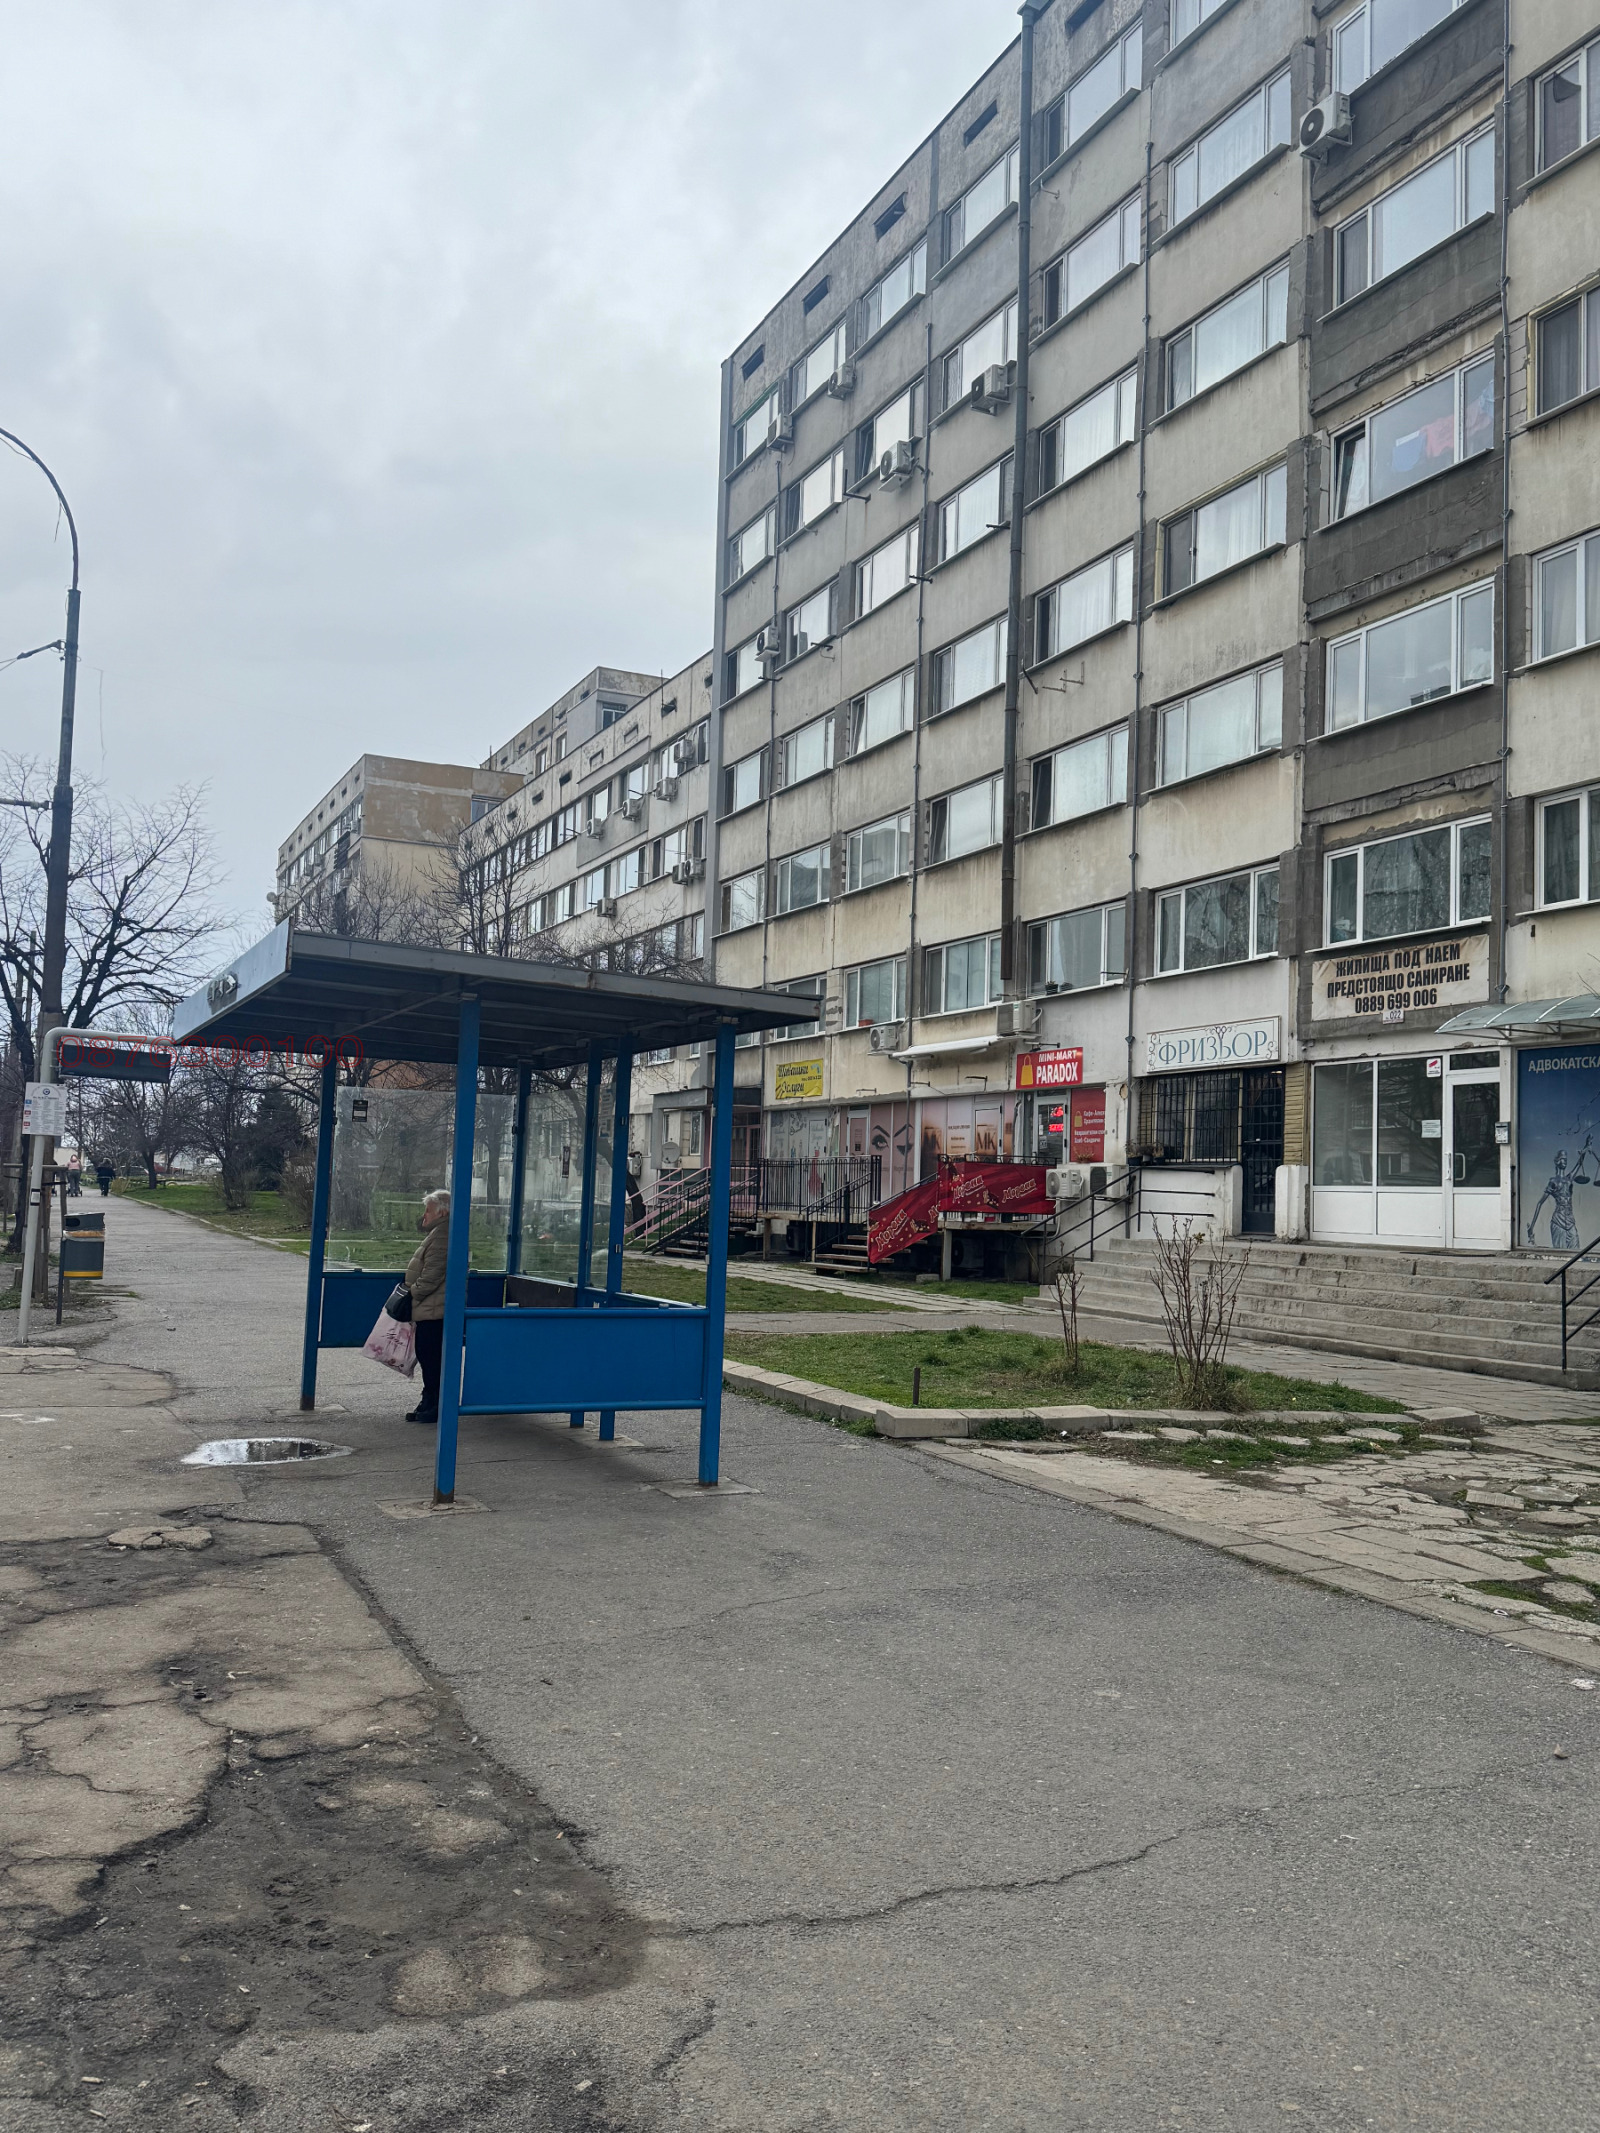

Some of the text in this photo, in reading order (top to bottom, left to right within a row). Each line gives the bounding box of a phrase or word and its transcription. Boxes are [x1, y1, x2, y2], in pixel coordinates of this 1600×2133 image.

[1336, 943, 1460, 977] ЖИЛИЩА ПОД НАЕМ
[1327, 963, 1470, 998] ПРЕДСТОЯЩО САНИРАНЕ
[1355, 988, 1437, 1014] 0889 699 006
[1038, 1050, 1077, 1063] MINI-MART
[1158, 1029, 1268, 1065] ФРИЗЬОР
[1036, 1062, 1078, 1084] PARADOX
